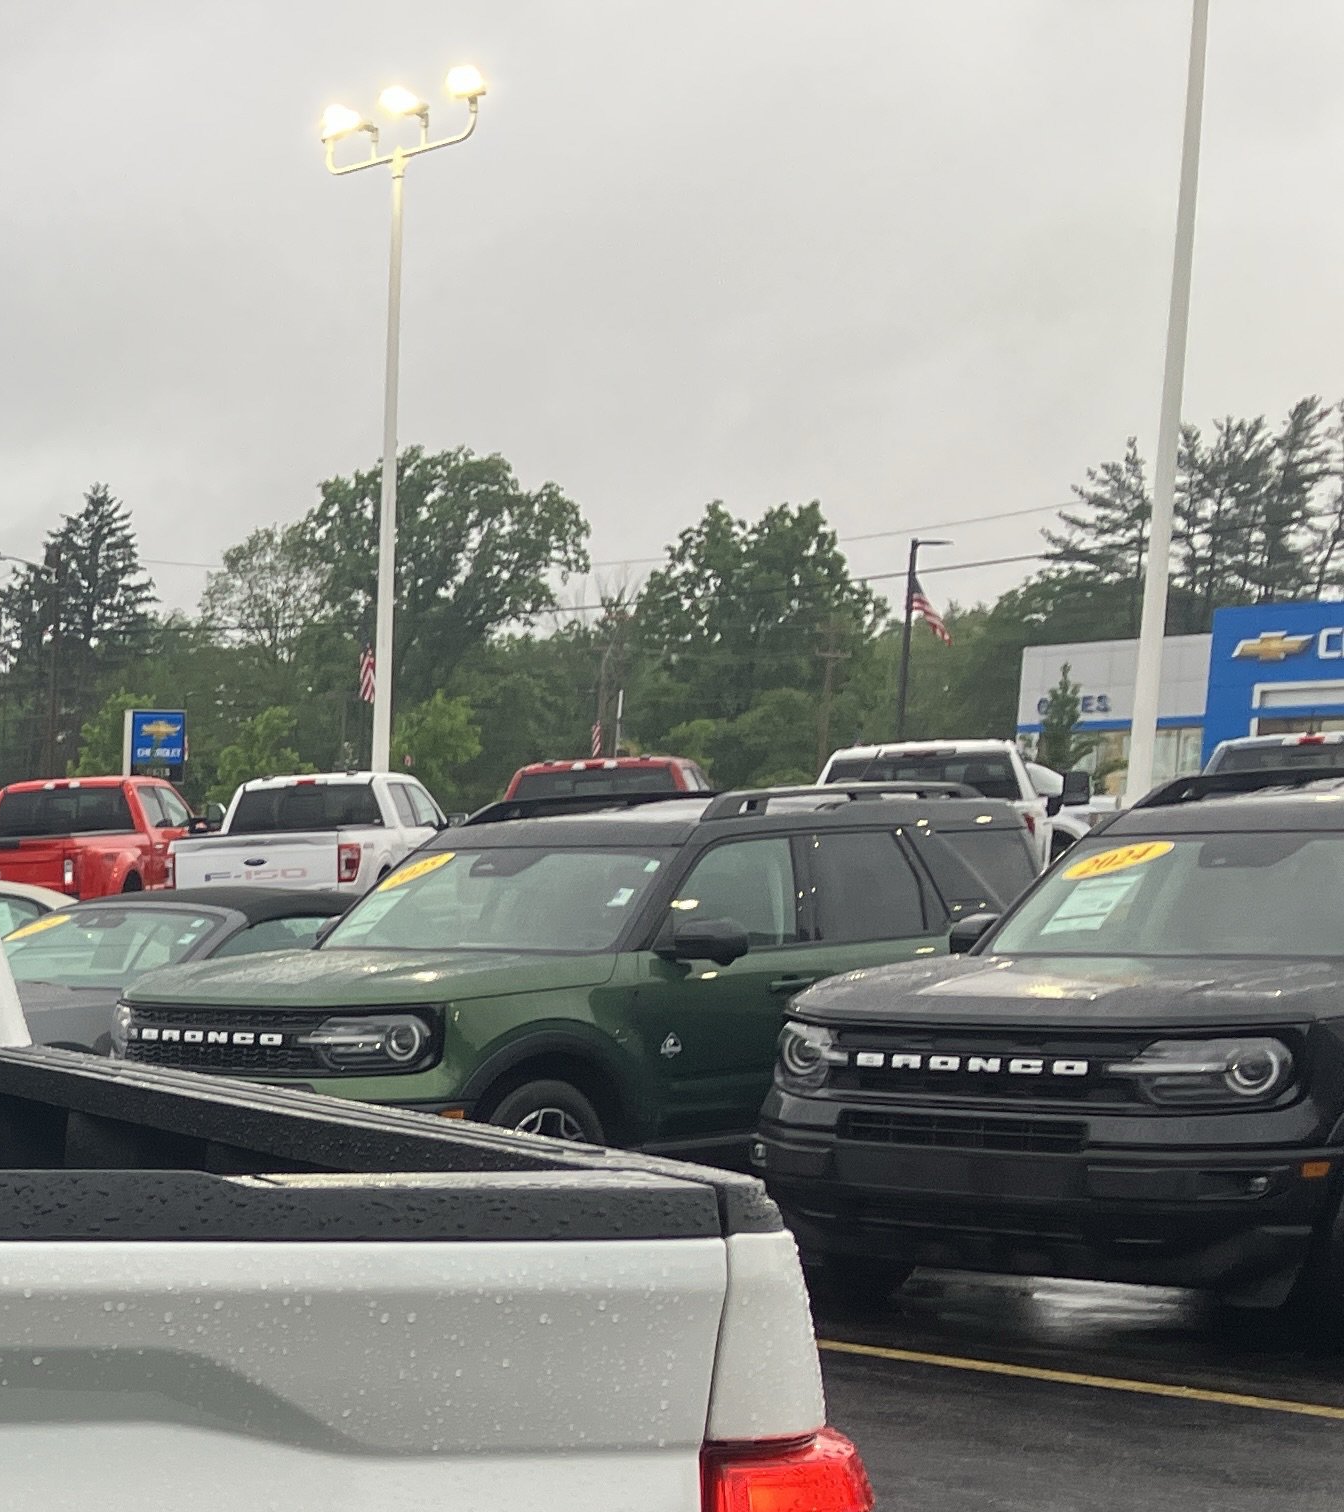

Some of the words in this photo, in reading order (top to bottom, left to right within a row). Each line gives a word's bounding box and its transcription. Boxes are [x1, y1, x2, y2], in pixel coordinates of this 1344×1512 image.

[1076, 844, 1157, 877] 2024
[204, 867, 308, 882] F-150
[141, 1028, 283, 1046] BRONCO
[856, 1052, 1089, 1076] BRONCO
